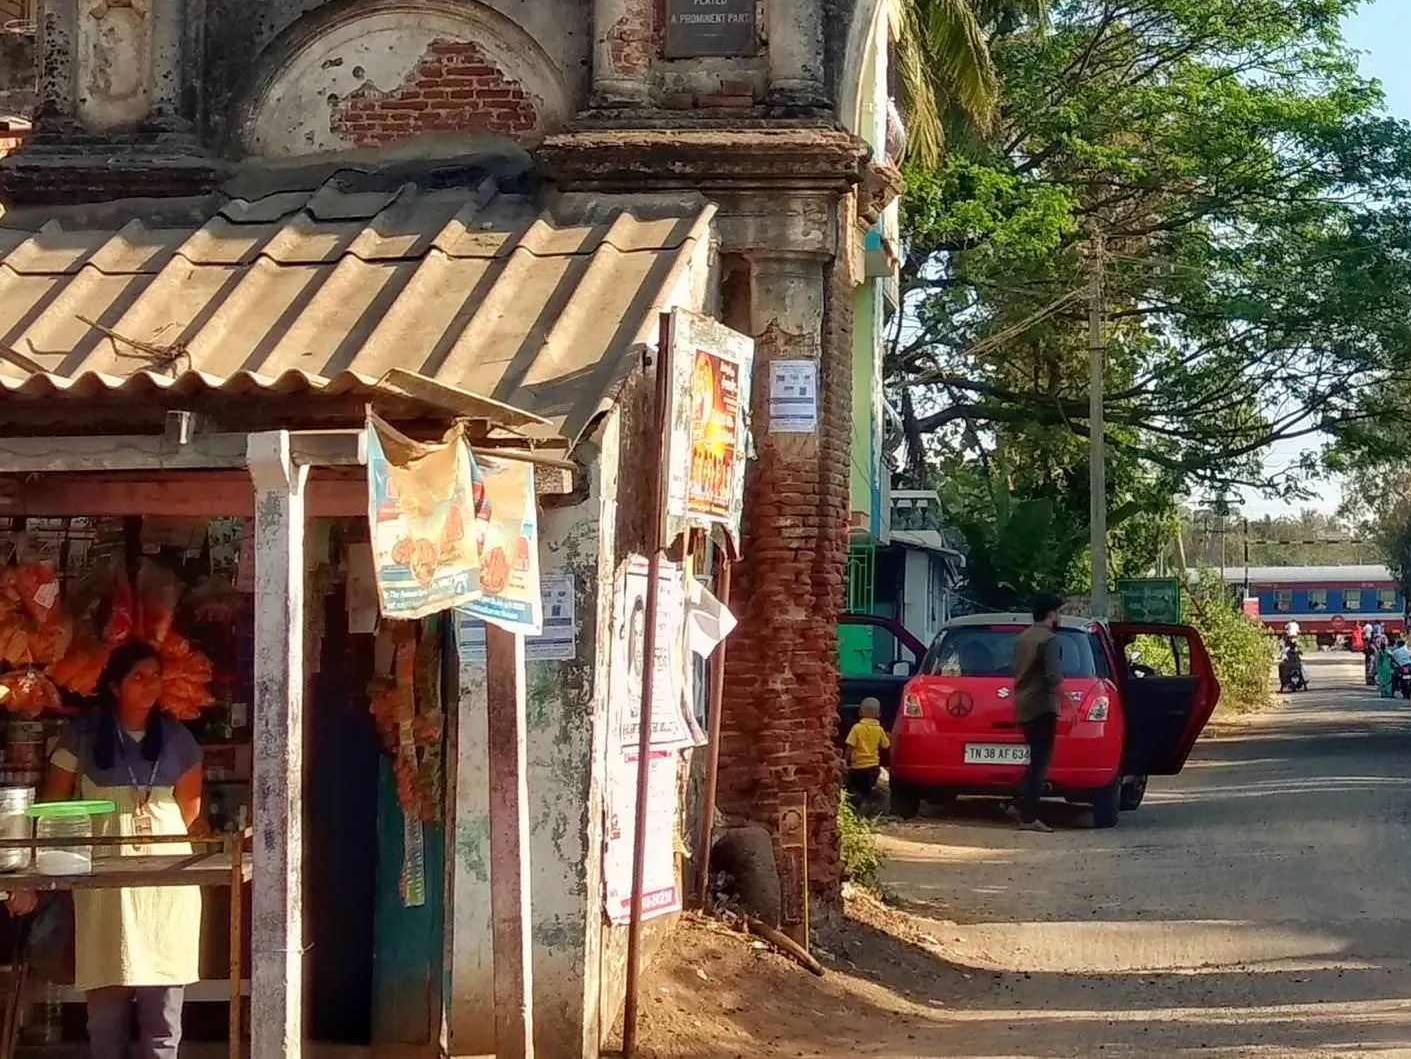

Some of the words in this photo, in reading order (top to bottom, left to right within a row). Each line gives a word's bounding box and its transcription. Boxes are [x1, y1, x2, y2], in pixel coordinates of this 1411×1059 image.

[680, 13, 726, 23] PROMINENT
[727, 13, 750, 23] PART
[970, 748, 982, 759] TN
[983, 748, 996, 759] 38
[998, 748, 1011, 759] AF
